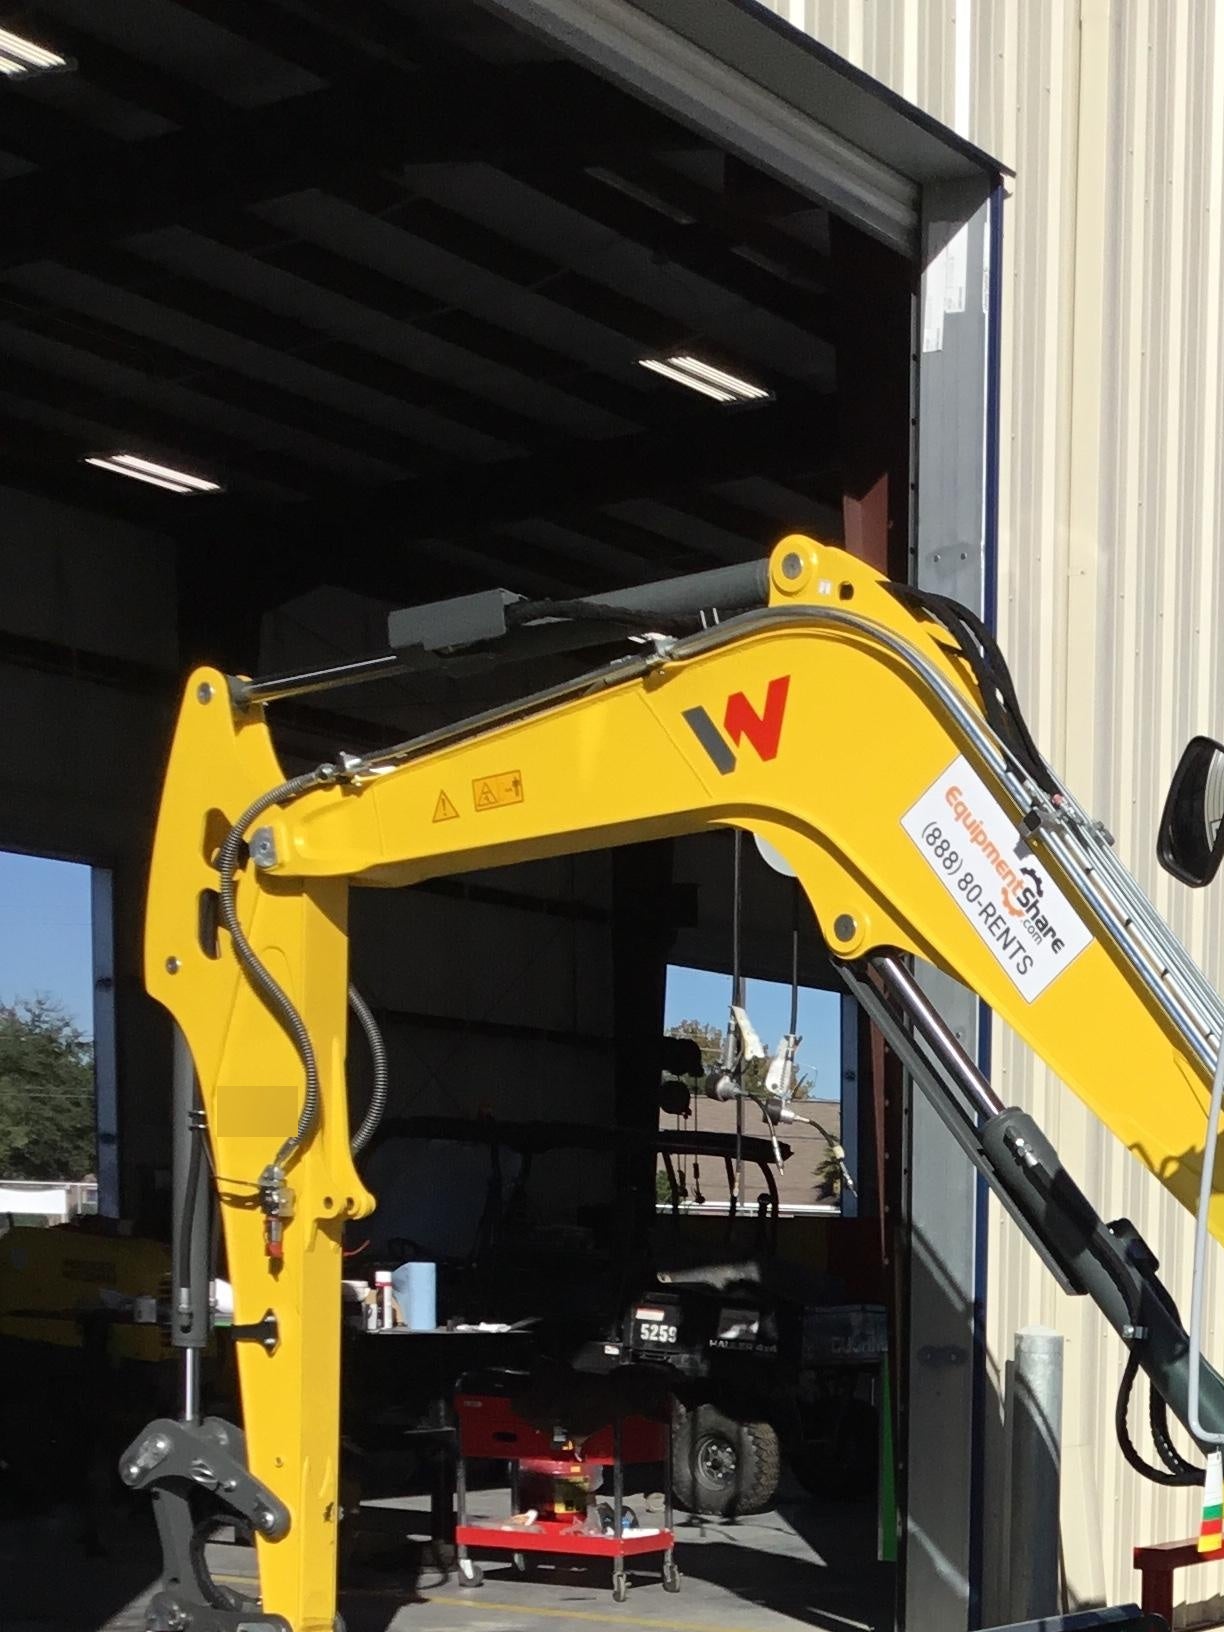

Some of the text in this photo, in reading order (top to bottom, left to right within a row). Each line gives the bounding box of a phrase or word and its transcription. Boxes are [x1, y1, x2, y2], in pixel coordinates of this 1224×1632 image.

[921, 821, 1034, 976] (888) 80-RENTS
[639, 1323, 678, 1344] 5259
